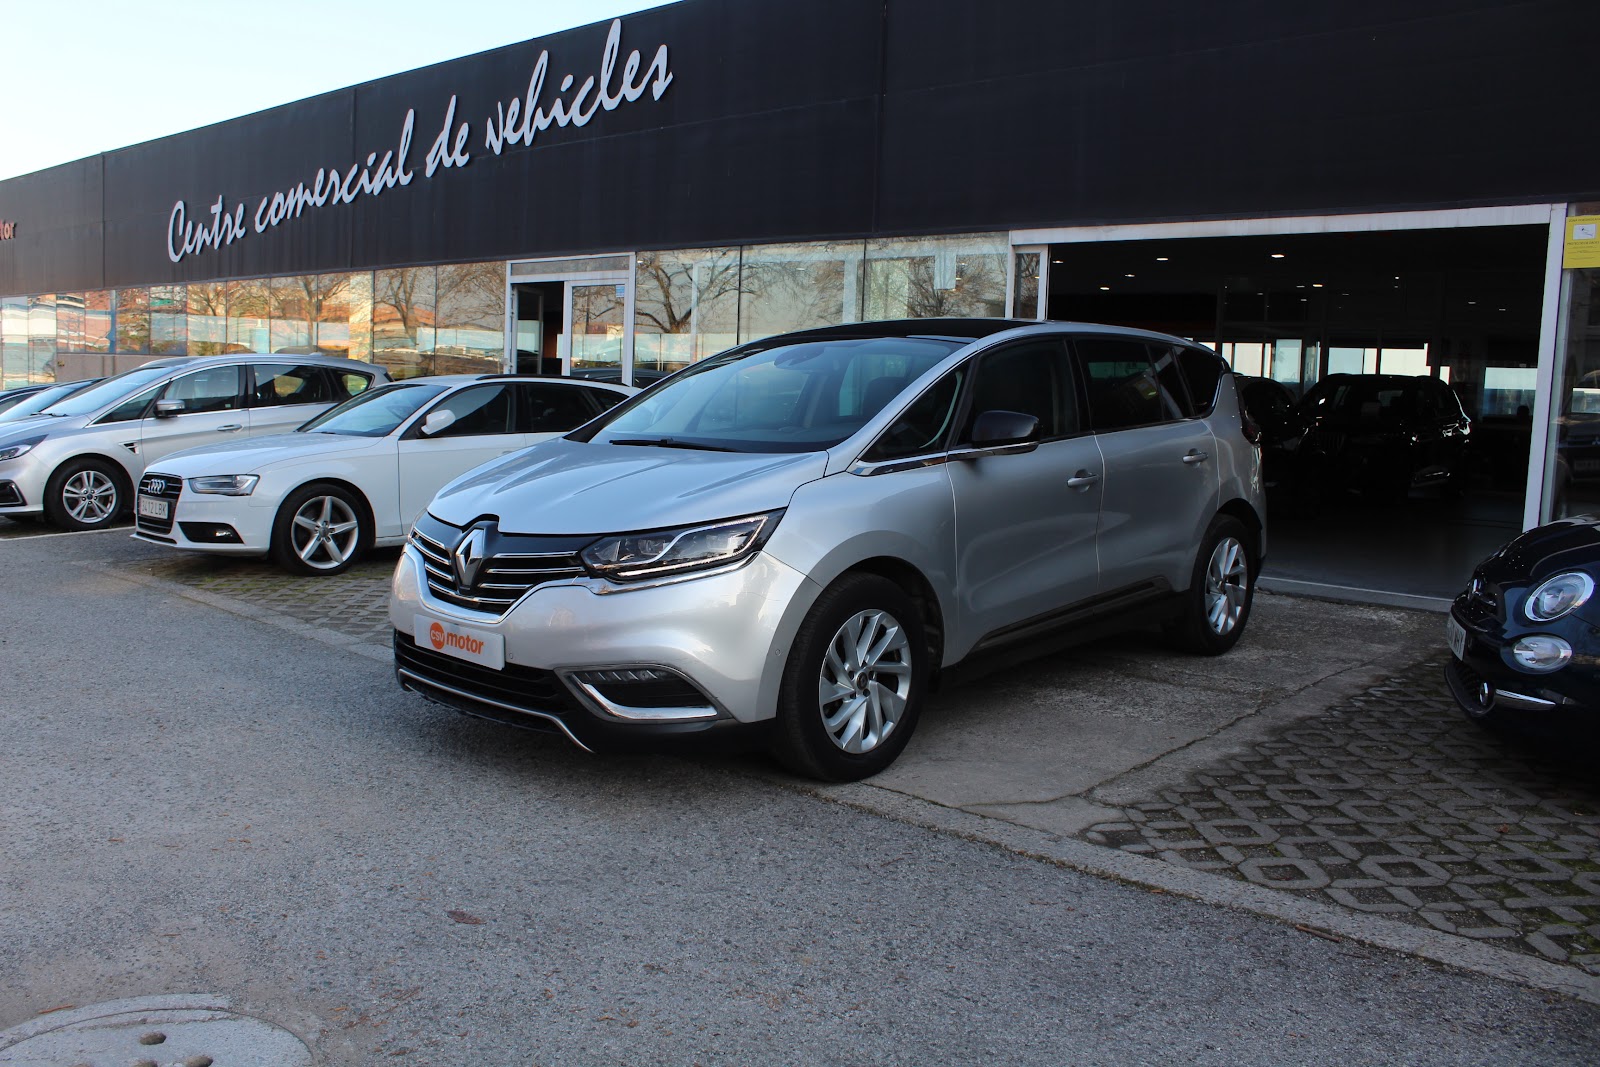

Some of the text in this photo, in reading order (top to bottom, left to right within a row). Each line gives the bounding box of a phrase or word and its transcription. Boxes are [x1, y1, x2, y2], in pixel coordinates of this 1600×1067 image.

[167, 19, 674, 263] Centre comercial de vehicles
[446, 632, 484, 654] motor
